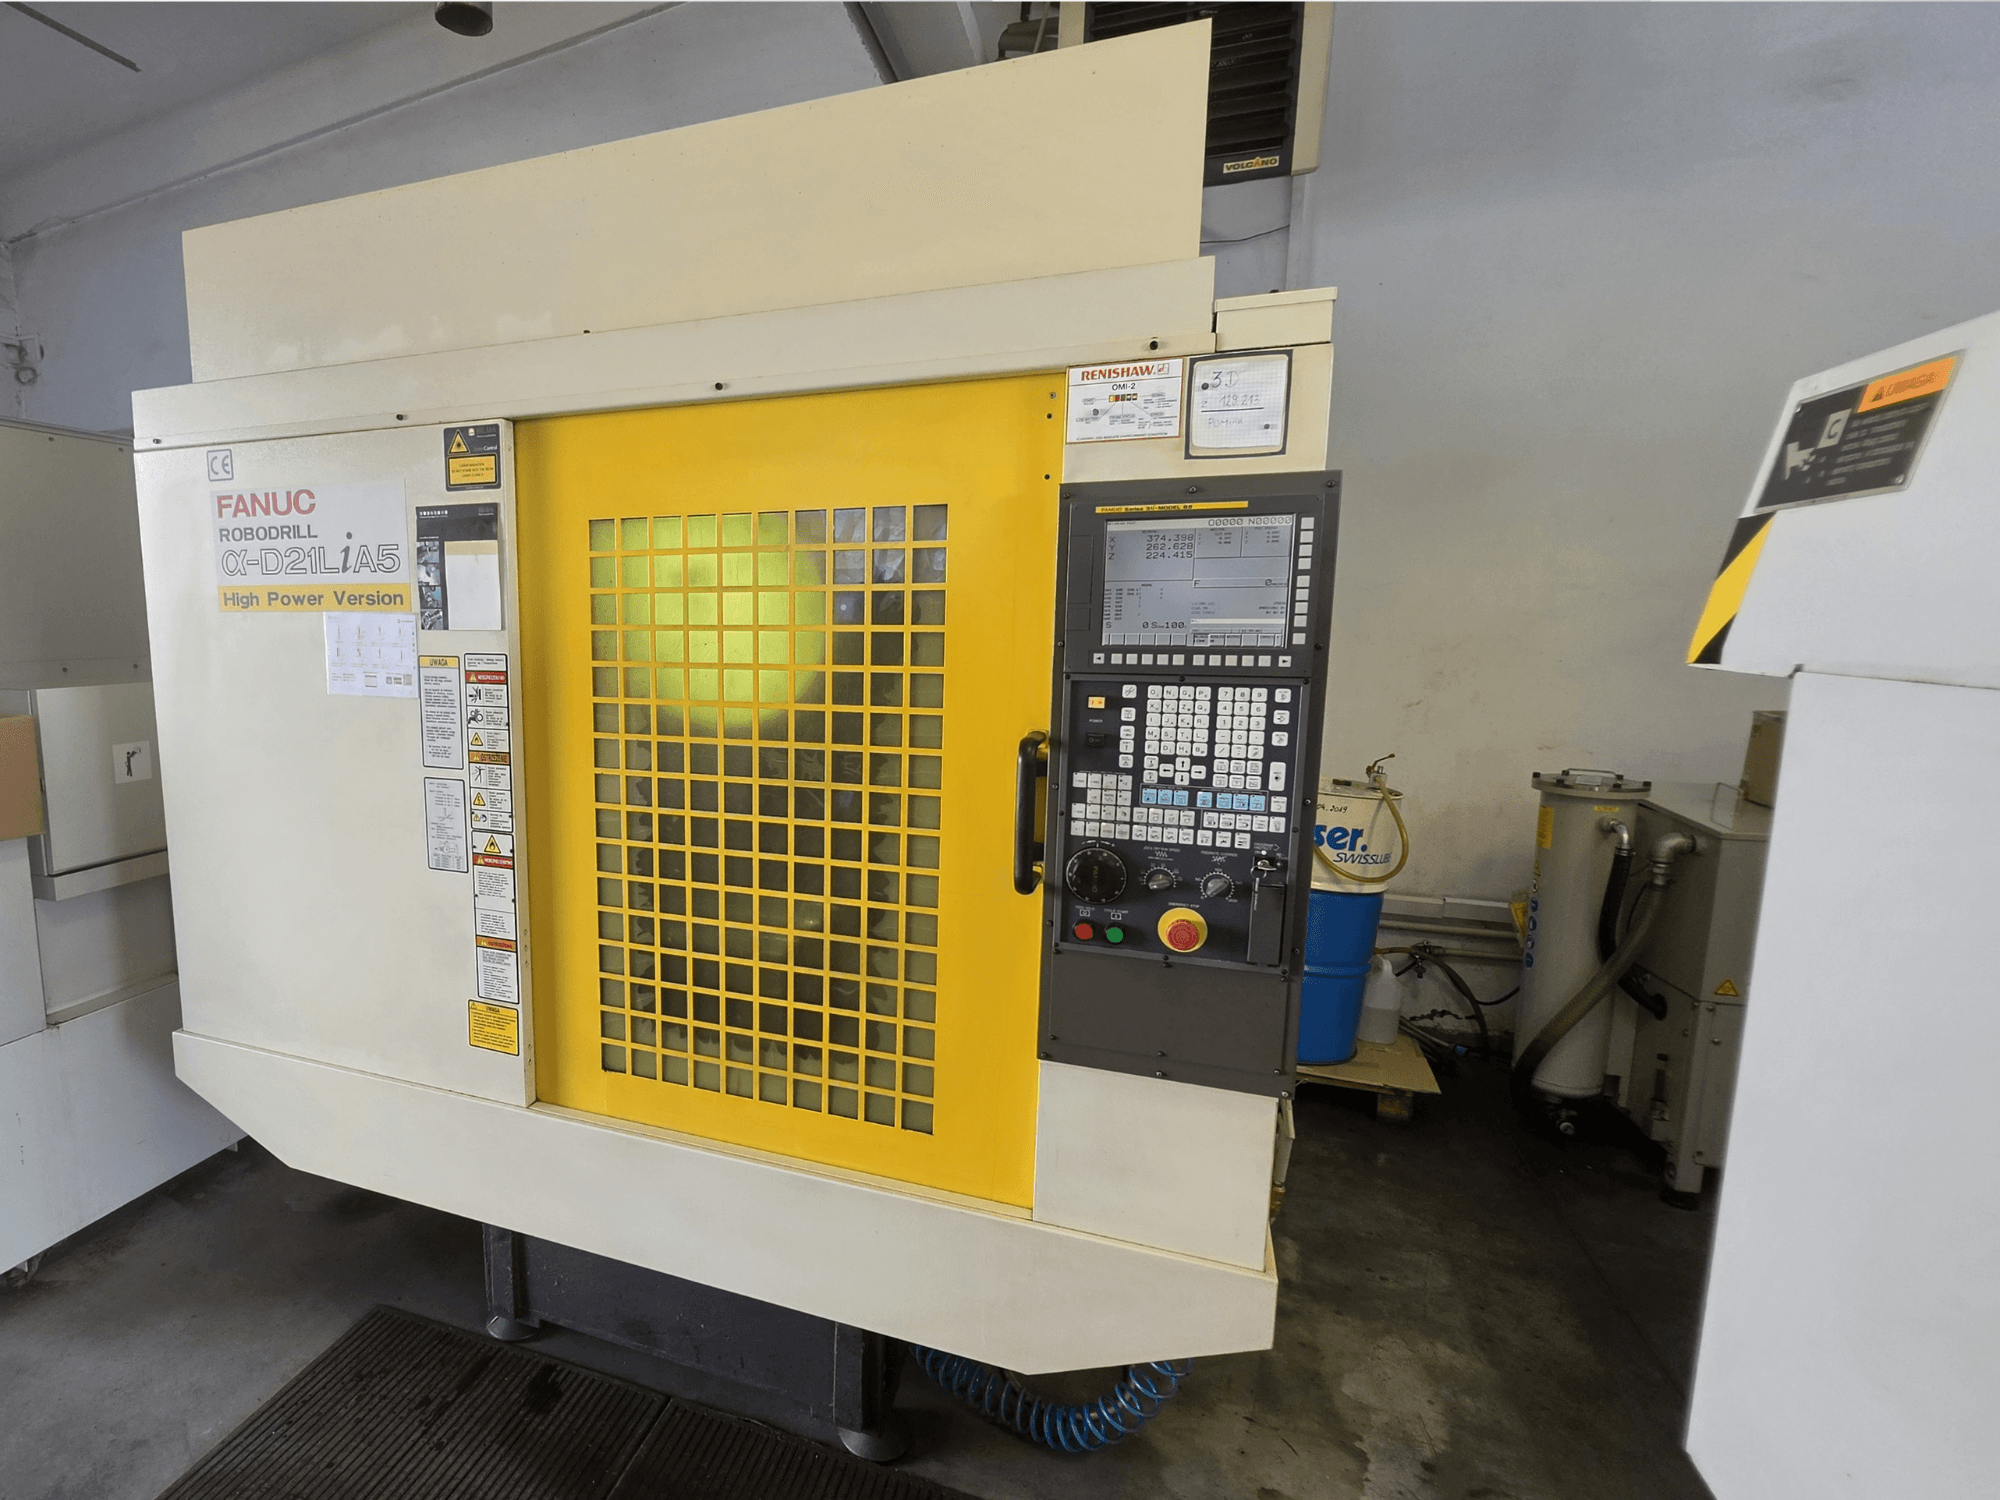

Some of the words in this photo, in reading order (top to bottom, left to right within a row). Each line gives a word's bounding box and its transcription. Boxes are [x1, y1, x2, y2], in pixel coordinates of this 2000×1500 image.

[1225, 158, 1277, 171] VOLCANO
[1081, 365, 1154, 381] RENISHAW
[217, 490, 316, 518] FANUC
[1248, 517, 1291, 525] N00000
[219, 524, 318, 542] ROBODRILL
[1146, 534, 1193, 542] 374.398
[1146, 542, 1193, 550] 262.628
[1146, 551, 1193, 559] 224.415
[223, 592, 260, 608] High
[268, 591, 324, 606] Power
[333, 590, 404, 606] Version
[430, 658, 448, 666] UWAGA
